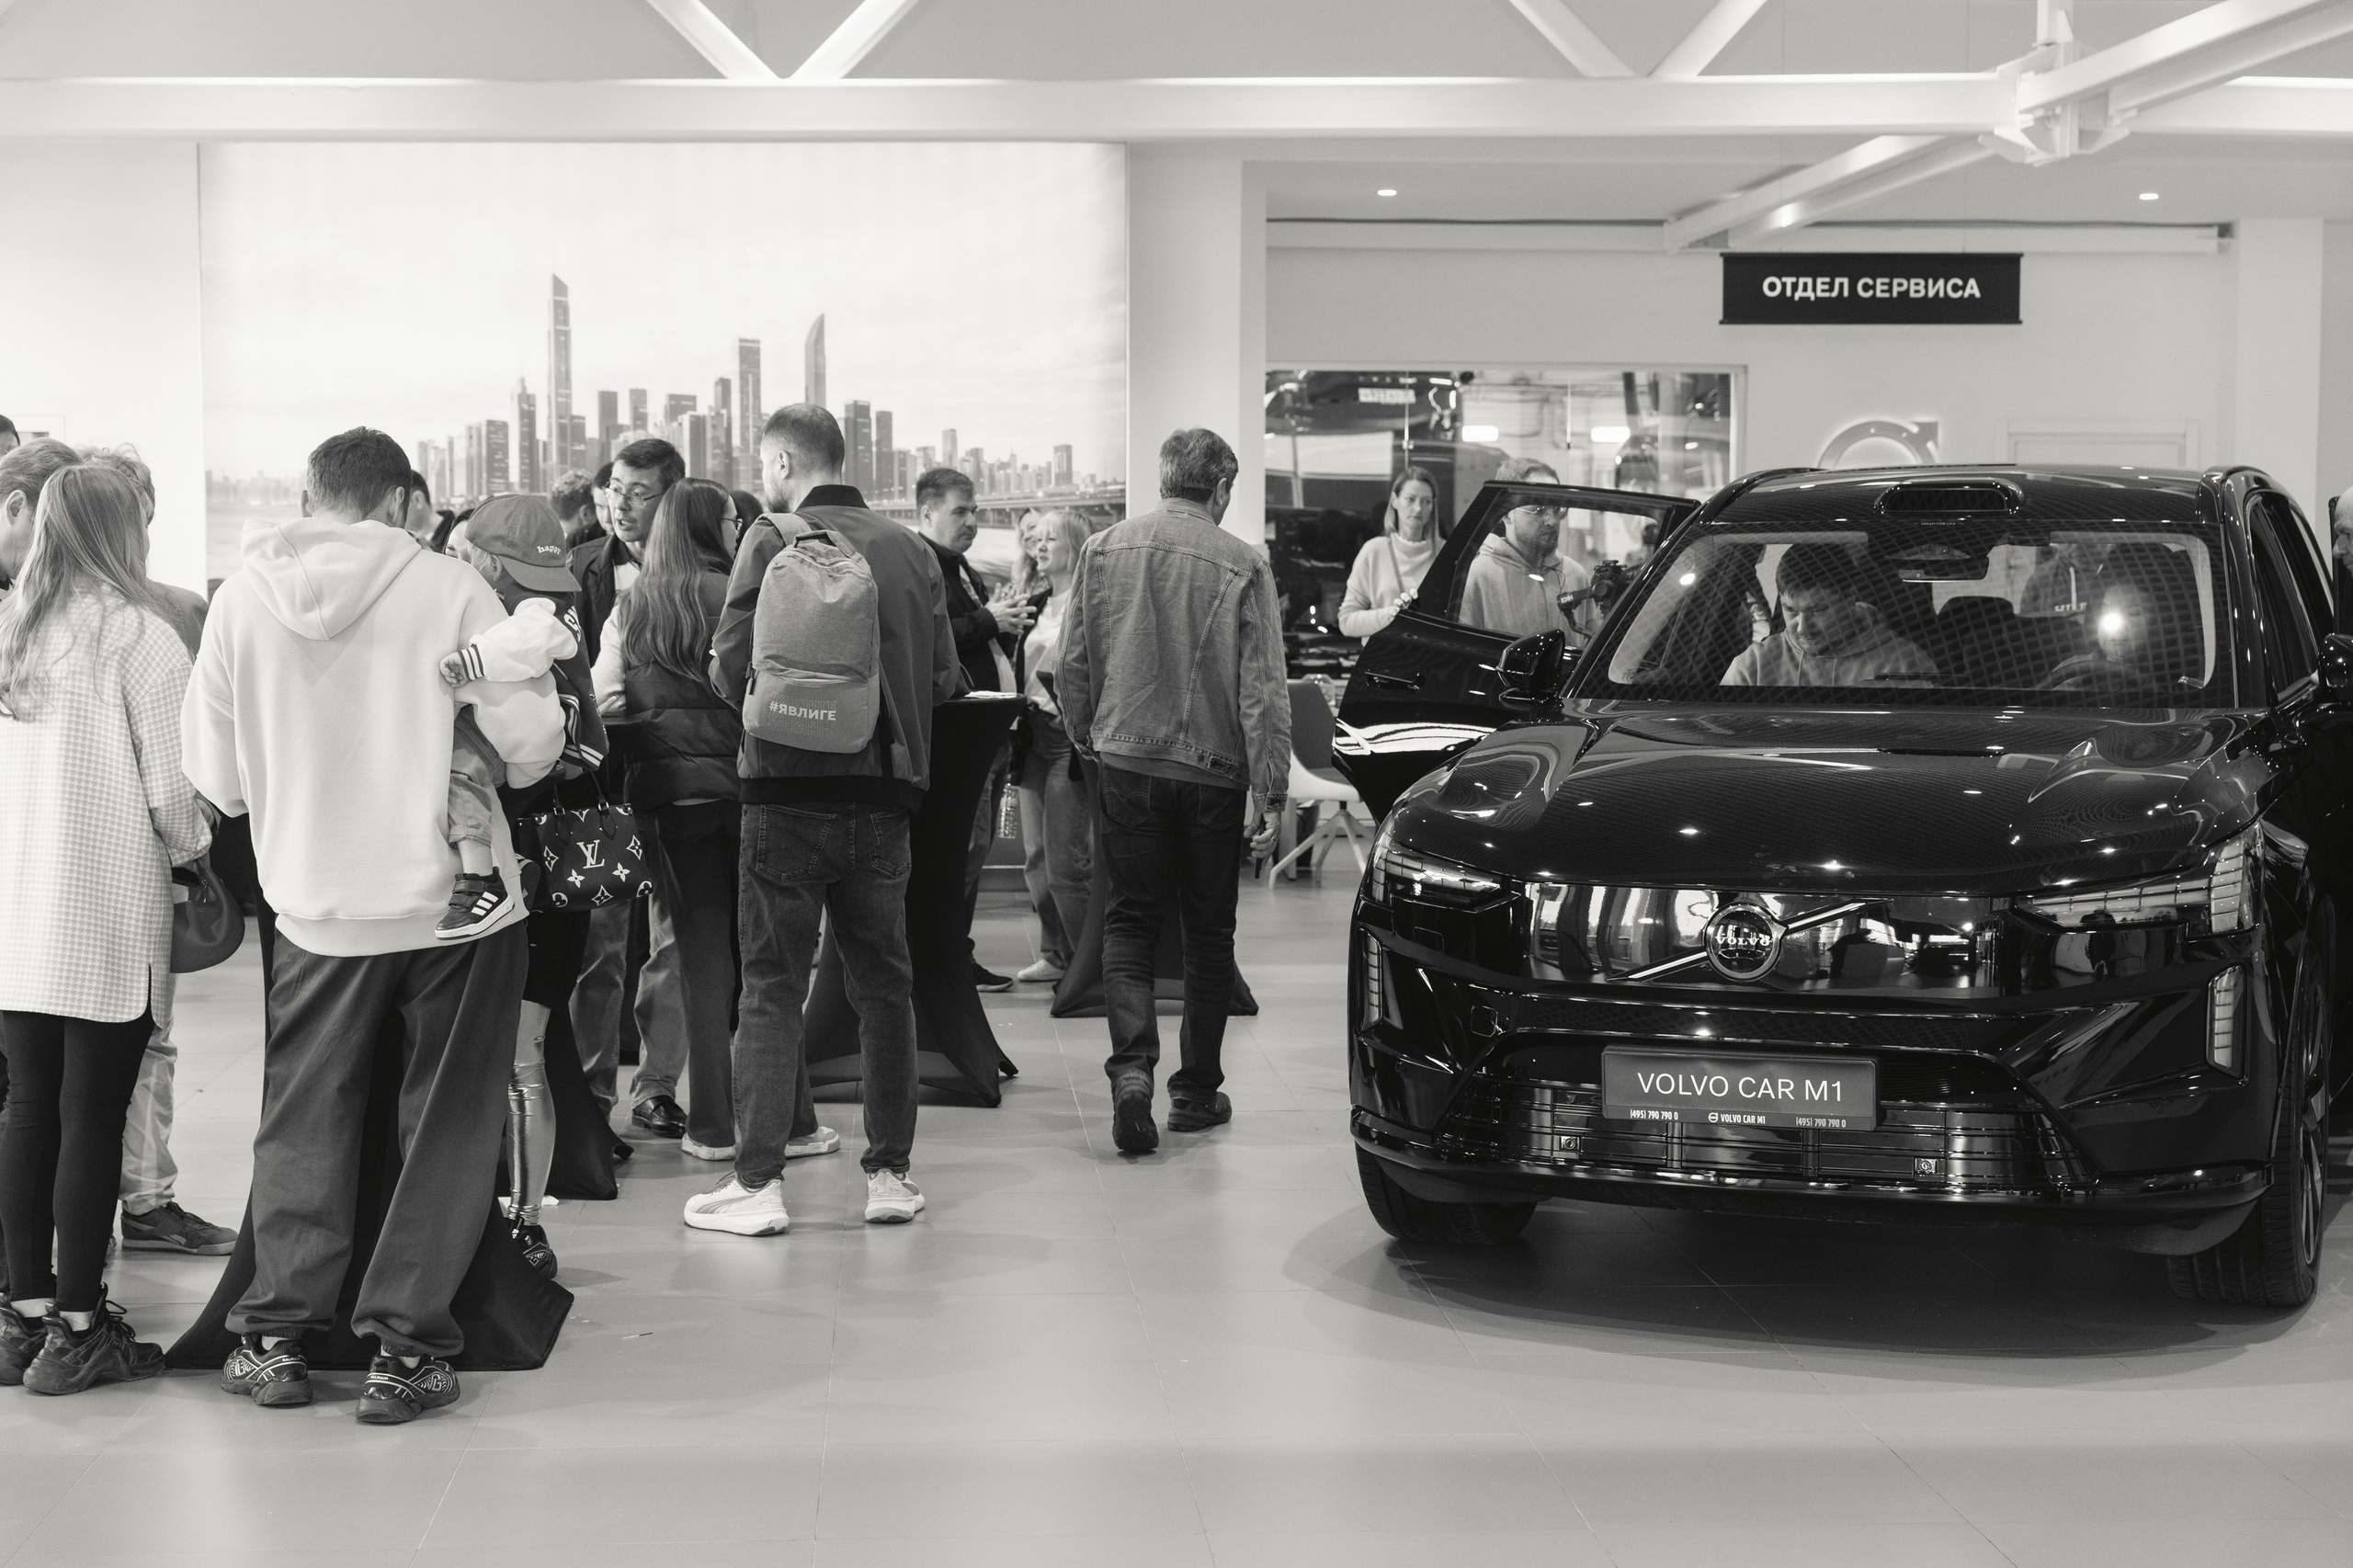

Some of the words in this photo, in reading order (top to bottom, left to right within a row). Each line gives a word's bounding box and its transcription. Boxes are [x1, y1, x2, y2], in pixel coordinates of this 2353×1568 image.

[1762, 276, 1849, 301] ОТДЕЛ
[1856, 277, 1982, 299] СЕРВИСА
[768, 700, 836, 722] #ЯВЛИГЕ
[576, 839, 605, 869] LV
[1715, 937, 1771, 947] VOLVO
[1637, 1073, 1729, 1097] VOLVO
[1738, 1077, 1795, 1100] CAR
[1804, 1079, 1842, 1102] M1
[1630, 1108, 1646, 1119] (495)
[1647, 1109, 1659, 1119] 790
[1660, 1110, 1673, 1120] 790
[1674, 1111, 1678, 1120] 0
[1720, 1113, 1742, 1123] VOLVO
[1743, 1114, 1756, 1124] CAR
[1756, 1115, 1766, 1124] M1
[1795, 1117, 1813, 1127] (495)
[1813, 1118, 1826, 1127] 790
[1827, 1119, 1840, 1128] 790
[1841, 1119, 1847, 1128] 0
